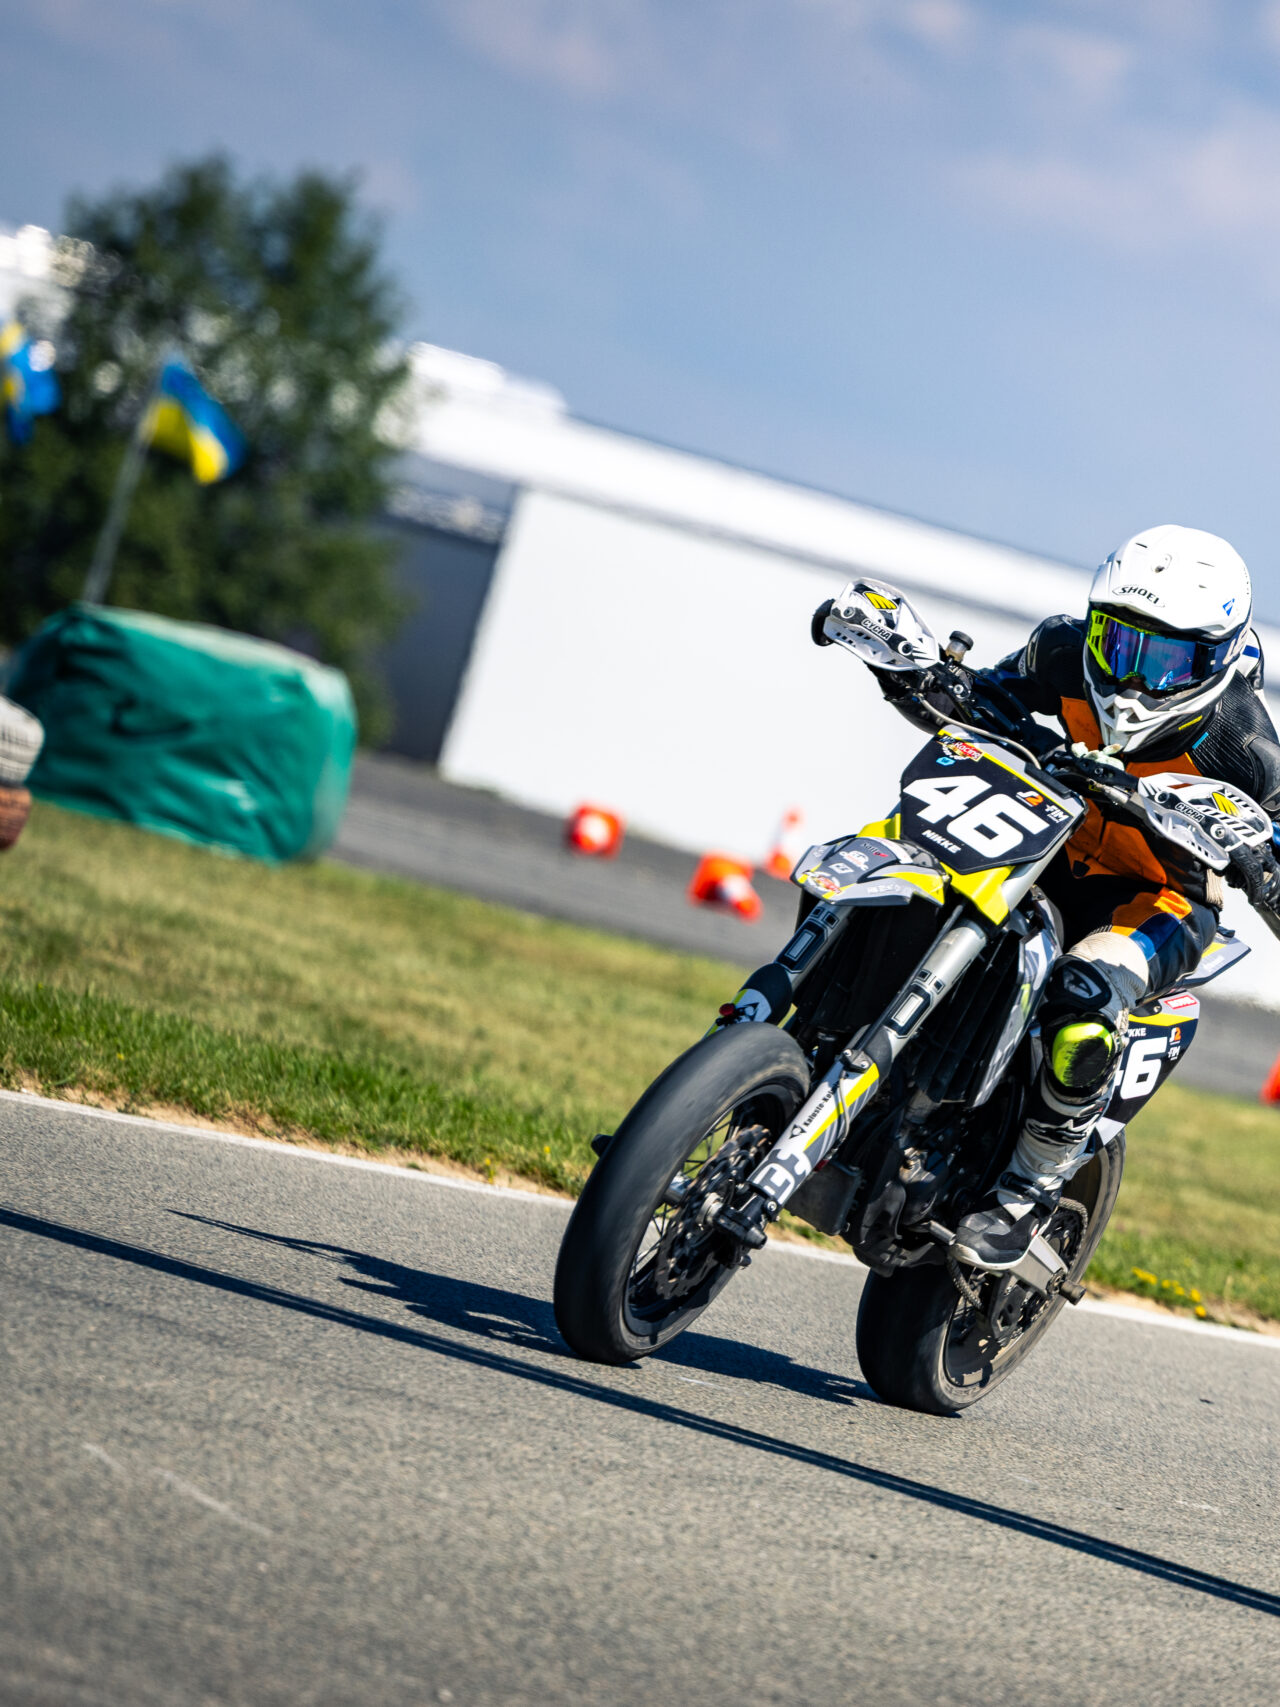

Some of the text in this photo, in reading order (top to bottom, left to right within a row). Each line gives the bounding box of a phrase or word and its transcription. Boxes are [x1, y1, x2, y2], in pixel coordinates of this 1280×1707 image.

[1119, 586, 1160, 605] SHOEI
[862, 618, 891, 639] CYCRA
[903, 775, 1050, 858] 46
[1176, 803, 1204, 822] CYCRA
[921, 829, 961, 854] NIKKE
